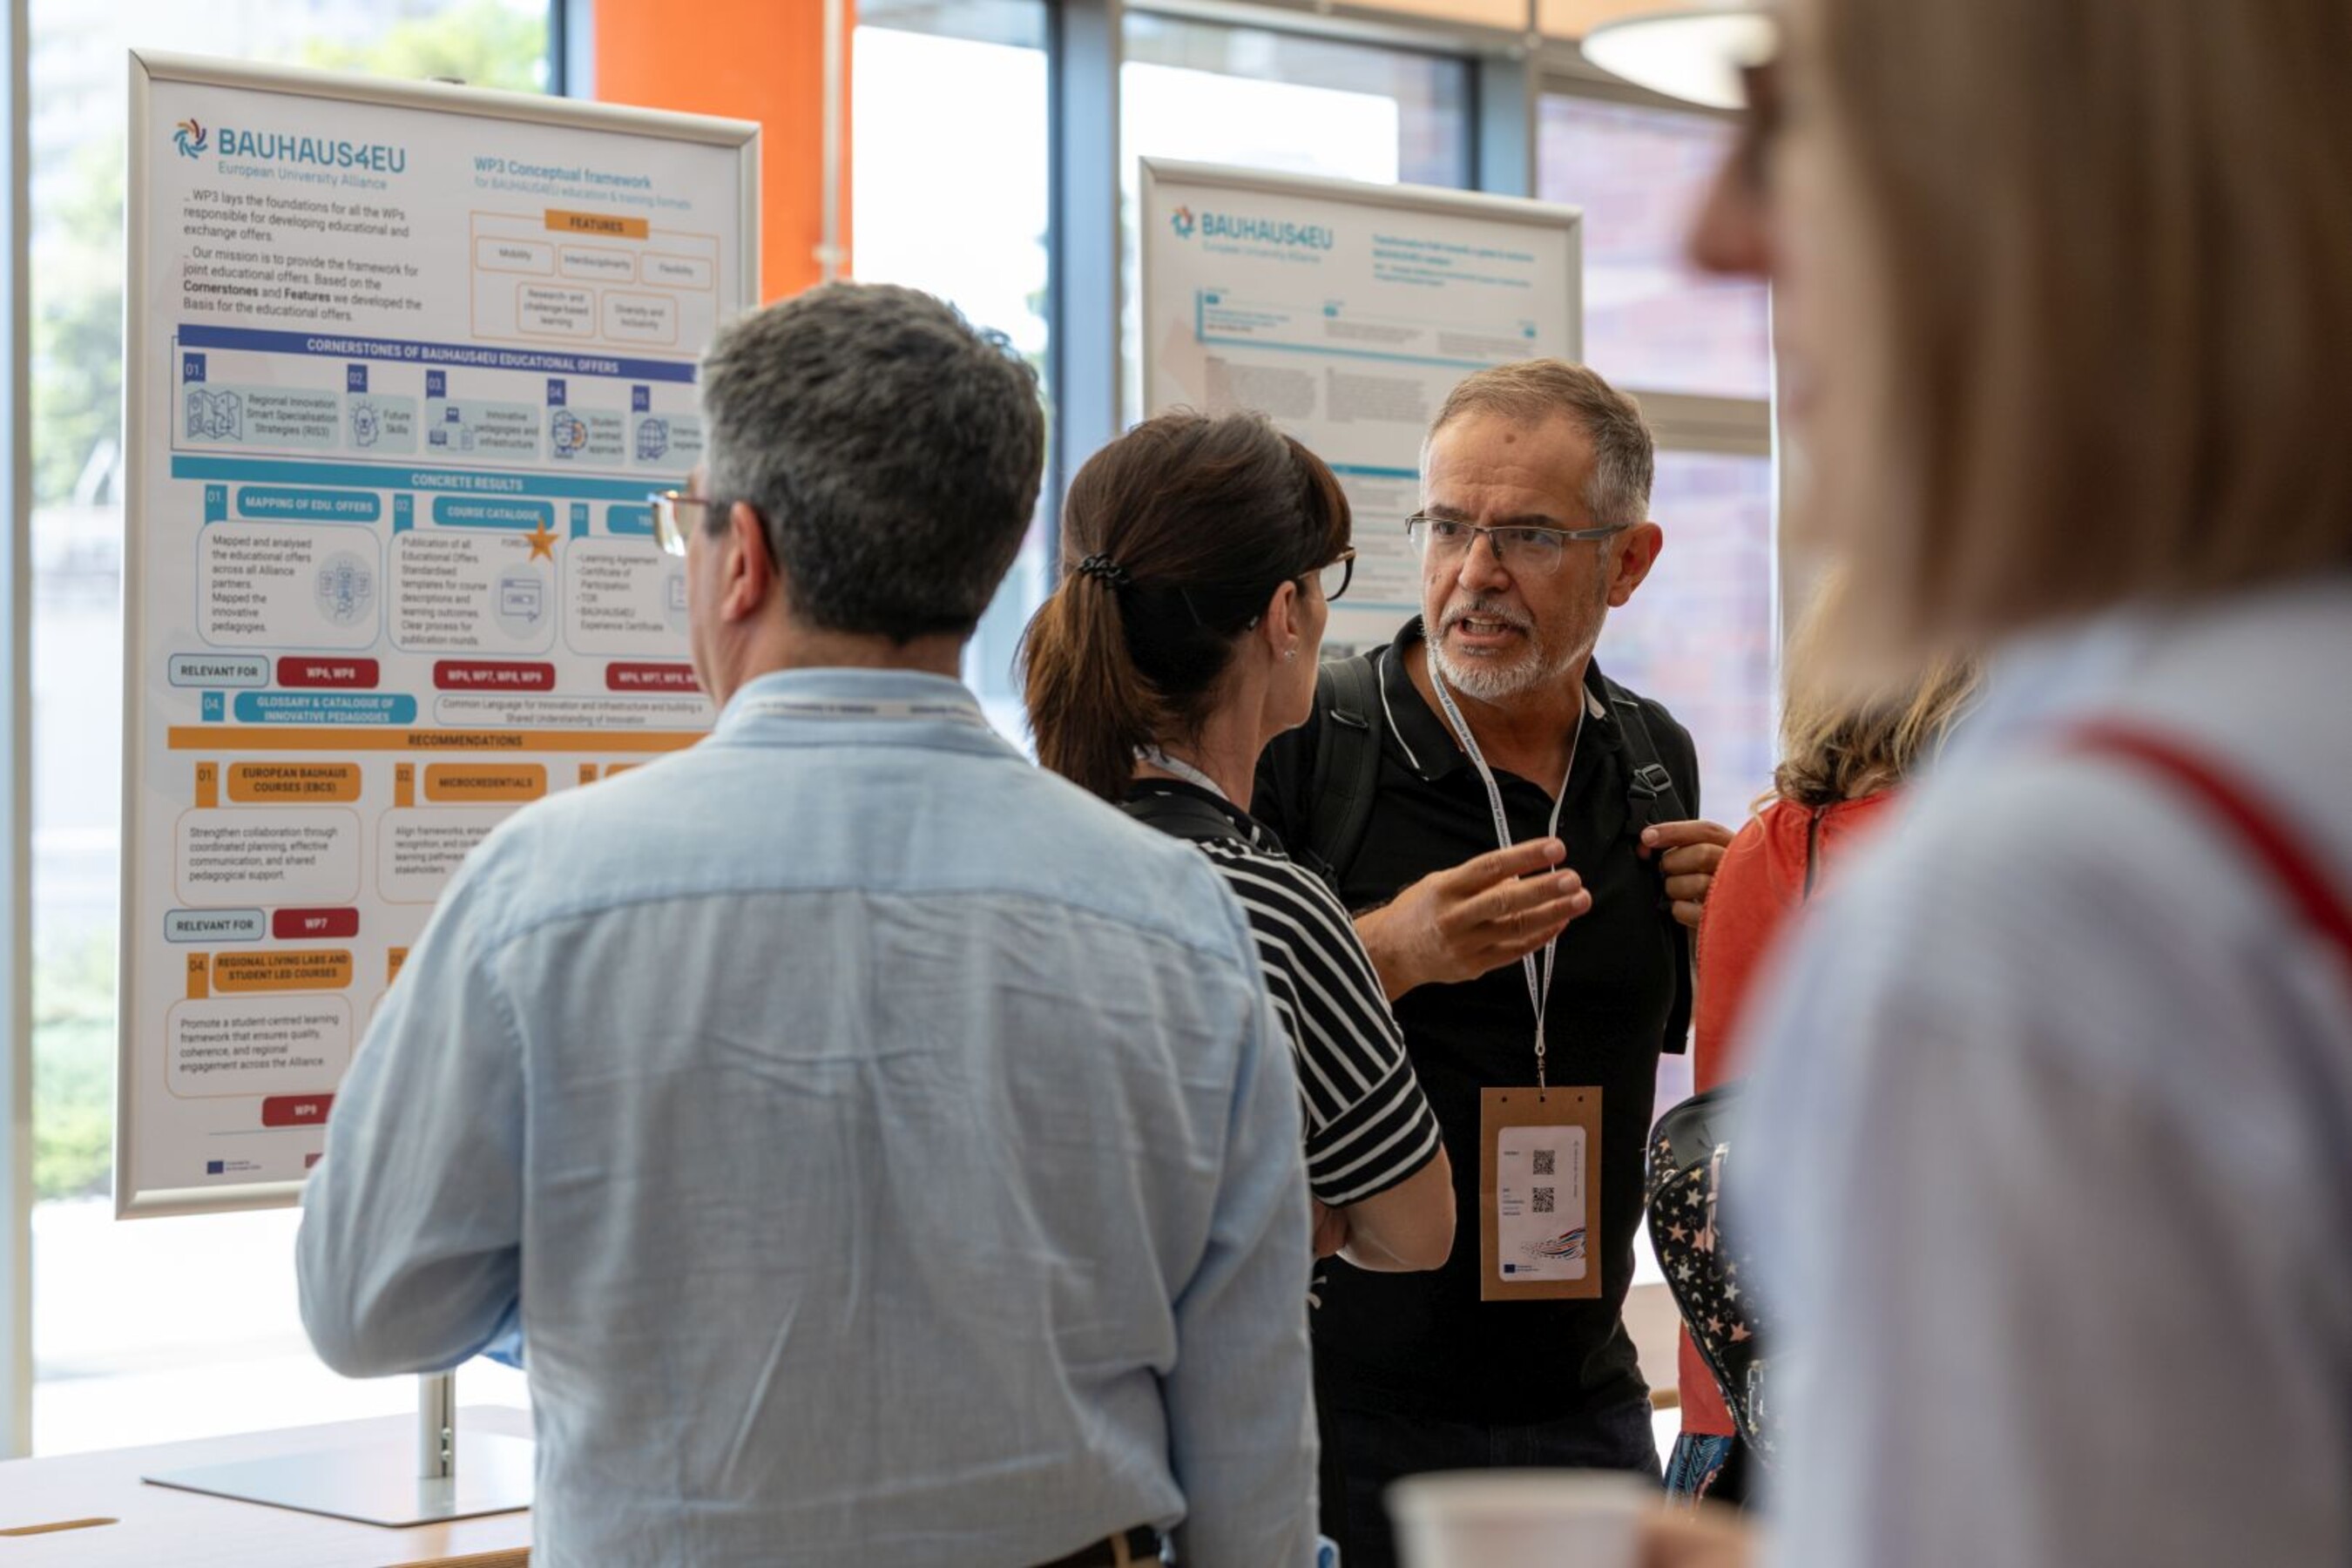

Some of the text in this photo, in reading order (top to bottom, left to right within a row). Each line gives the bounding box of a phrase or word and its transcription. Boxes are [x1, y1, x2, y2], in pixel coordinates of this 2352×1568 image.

[220, 129, 406, 172] BAUHAUS4EU
[218, 162, 387, 189] European University Alliance
[474, 157, 652, 188] WP3 Conceptual framework
[193, 190, 404, 220] WP3 lays the foundations for all the WPs
[185, 207, 409, 237] responsible for developing educational and
[570, 217, 624, 232] FEATURES
[185, 225, 274, 241] exchange offers.
[1202, 213, 1333, 249] BAUHAUS4EU
[193, 246, 418, 277] Our mission is to provide the framework for
[183, 264, 382, 289] joint educational offers. Based on the
[183, 280, 422, 310] Cornerstones and Features we developed the
[183, 298, 352, 321] Basis for the educational offers.
[307, 339, 618, 373] CORNERSTONES OF BAUHAUS4EU EDUCATIONAL OFFERS
[185, 364, 204, 375] 01.
[246, 409, 338, 424] Smart Specialisation
[383, 410, 411, 421] Future
[411, 476, 523, 490] CONCRETE RESULTS
[246, 497, 373, 512] MAPPING OF EDU. OFFERS
[448, 507, 540, 520] COURSE CATALOGUE
[213, 536, 312, 549] Mapped and analysed
[213, 551, 310, 562] the educational offers
[246, 566, 256, 575] all
[258, 566, 294, 576] Alliance
[213, 593, 267, 605] Mapped the
[213, 608, 260, 617] innovative
[181, 666, 258, 677] RELEVANT FOR
[256, 698, 394, 708] GLOSSARY & CATALOGUE OF
[265, 712, 390, 721] INNOVATIVE PEDAGOGIES
[408, 735, 523, 747] RECOMMENDATIONS
[242, 768, 347, 777] EUROPEAN BAUHAUS
[439, 779, 533, 787] MICROCREDENTIALS
[190, 828, 338, 839] Strengthen collaboration through
[188, 841, 245, 851] coordinated
[289, 841, 328, 851] effective
[188, 855, 315, 865] communication, and shared
[188, 871, 246, 882] pedagogical
[176, 920, 253, 930] RELEVANT FOR
[305, 919, 328, 929] WP7
[218, 955, 348, 967] REGIONAL LIVING LABS AND
[228, 969, 336, 980] STUDENT LED COURSES
[181, 1017, 221, 1028] Promote
[303, 1015, 340, 1026] learning
[181, 1031, 230, 1042] framework
[231, 1031, 250, 1041] that
[232, 1045, 249, 1056] and
[251, 1044, 287, 1057] regional
[179, 1060, 237, 1073] engagement
[271, 1058, 286, 1068] the
